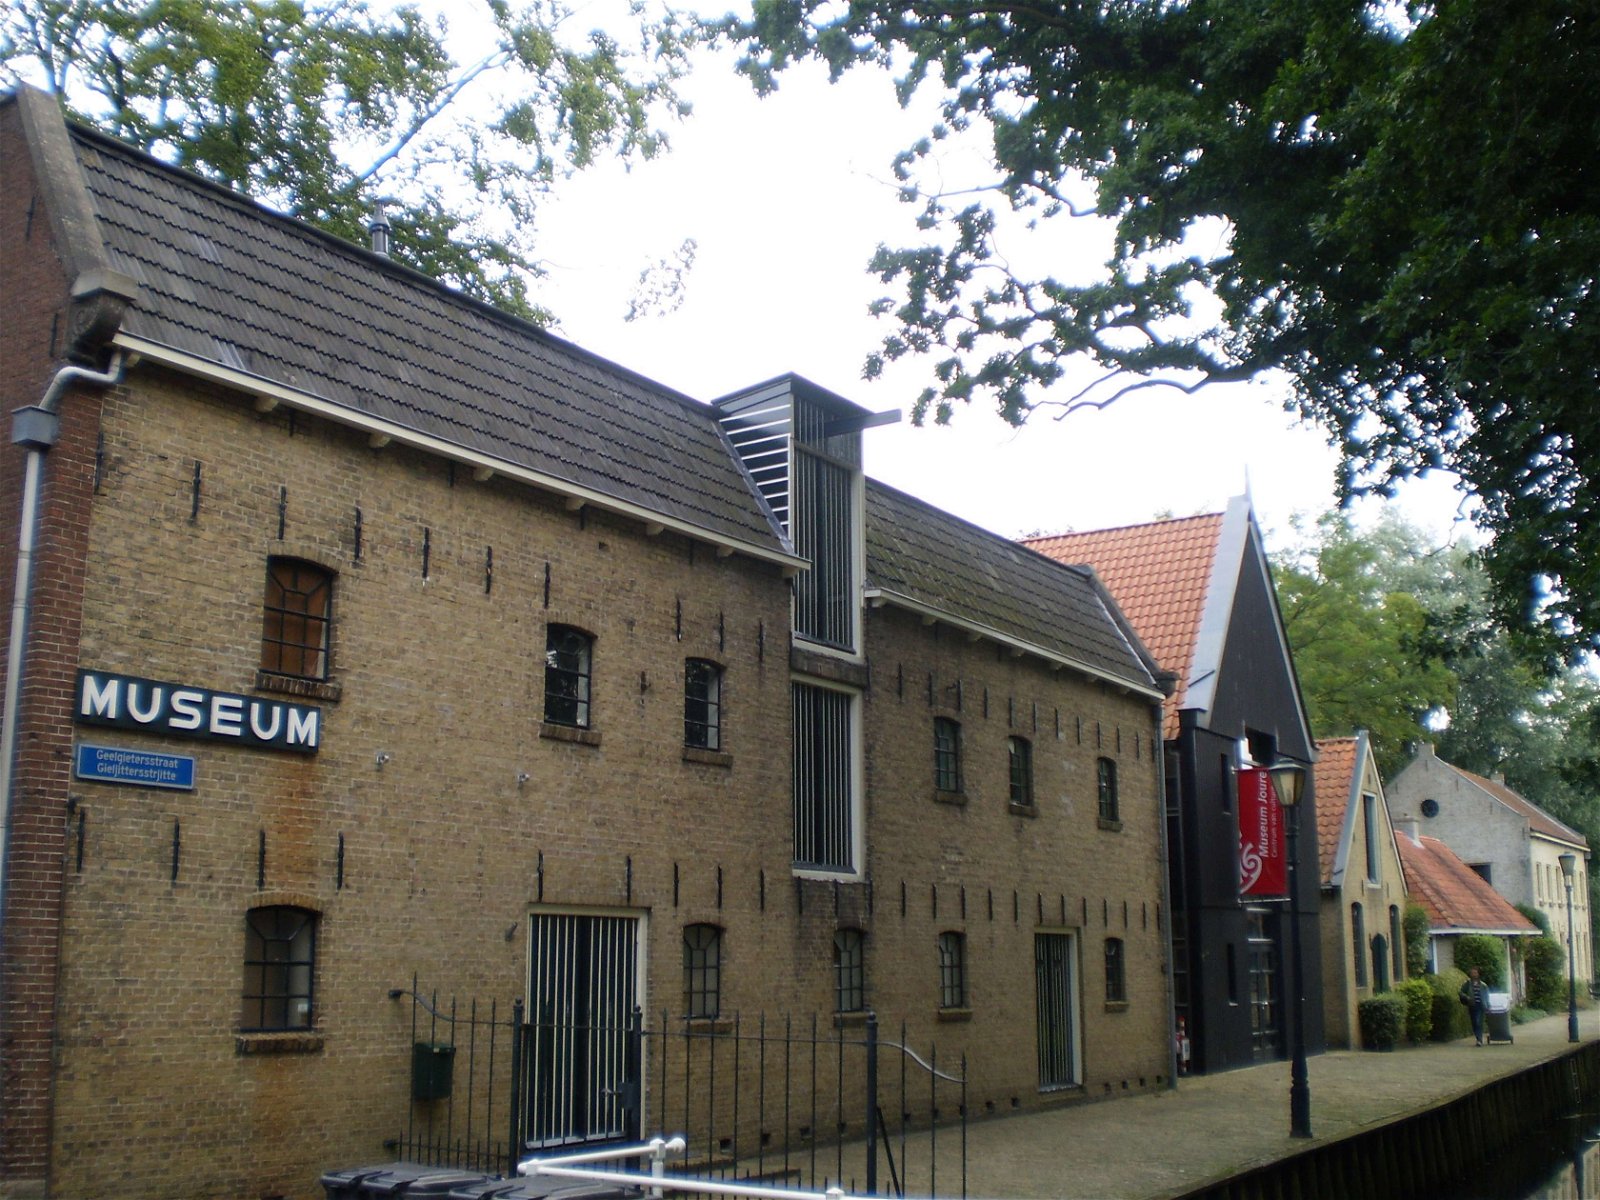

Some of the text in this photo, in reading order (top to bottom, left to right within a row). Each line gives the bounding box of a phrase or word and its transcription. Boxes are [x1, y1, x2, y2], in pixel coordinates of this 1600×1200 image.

[81, 675, 317, 747] MUSEUM
[96, 749, 178, 769] Geelgietersstraat
[97, 763, 176, 781] Gieljittersstrjitte
[1258, 771, 1269, 858] Museum Joure
